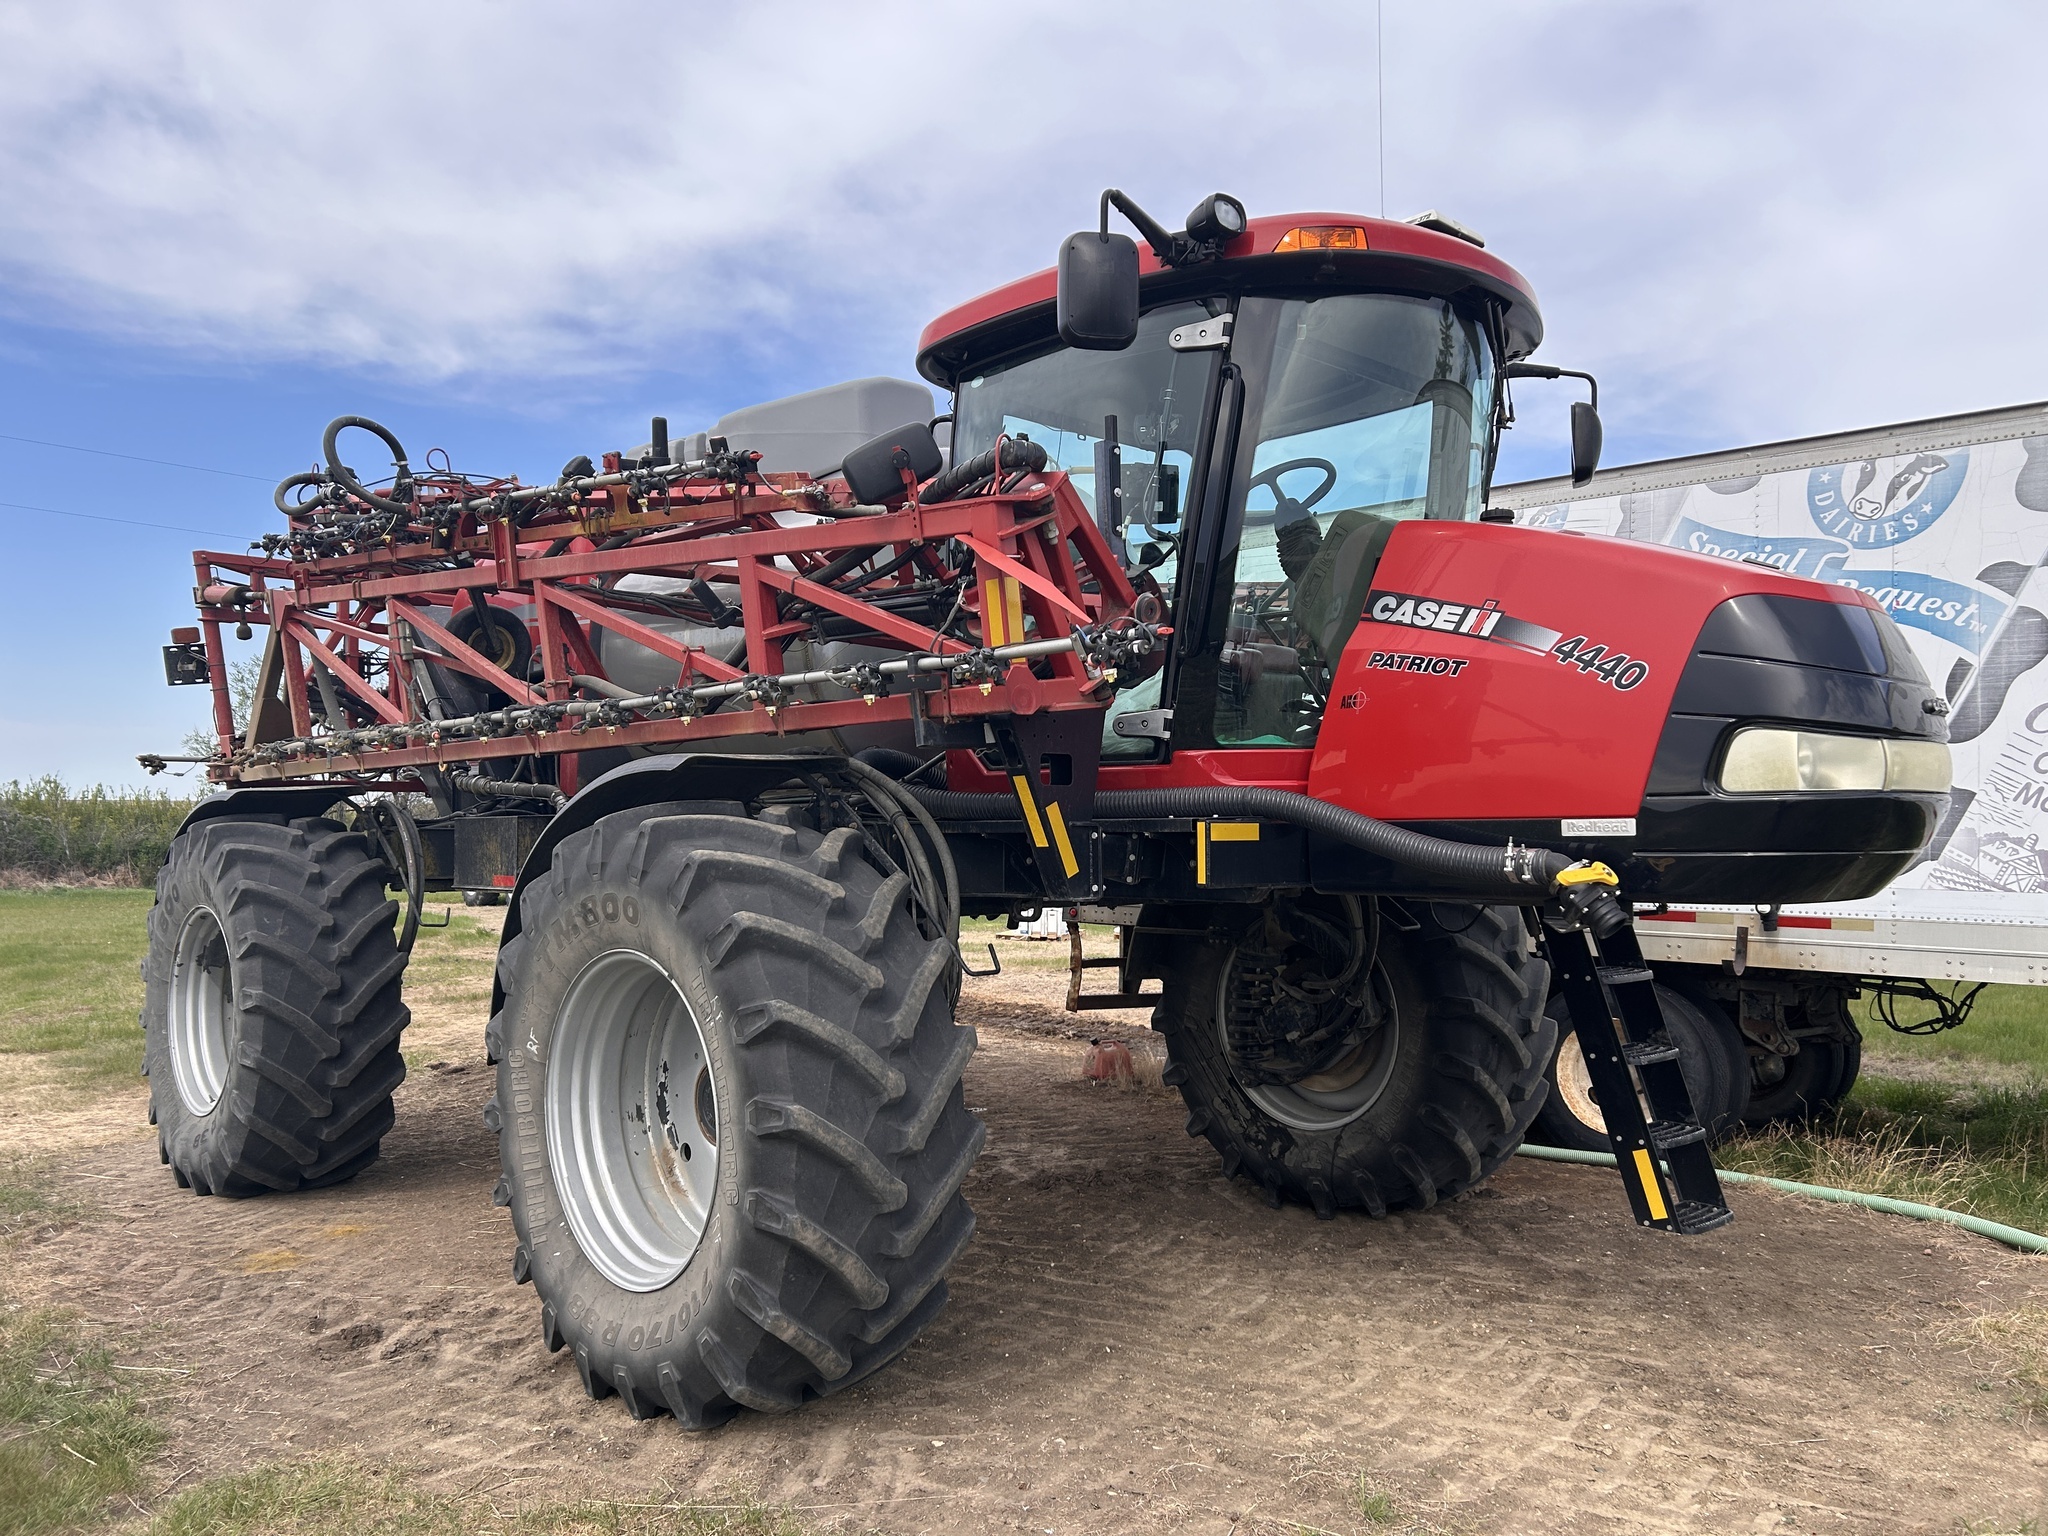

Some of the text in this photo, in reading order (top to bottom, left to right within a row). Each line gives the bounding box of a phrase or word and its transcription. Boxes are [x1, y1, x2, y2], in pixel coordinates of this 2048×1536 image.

[1814, 491, 1920, 544] DAIRIES
[1370, 595, 1465, 631] CASE
[1366, 651, 1470, 678] PATRIOT
[1551, 635, 1650, 692] 4440
[1566, 820, 1630, 833] Redhead
[508, 1048, 549, 1252] TRELLEBORG
